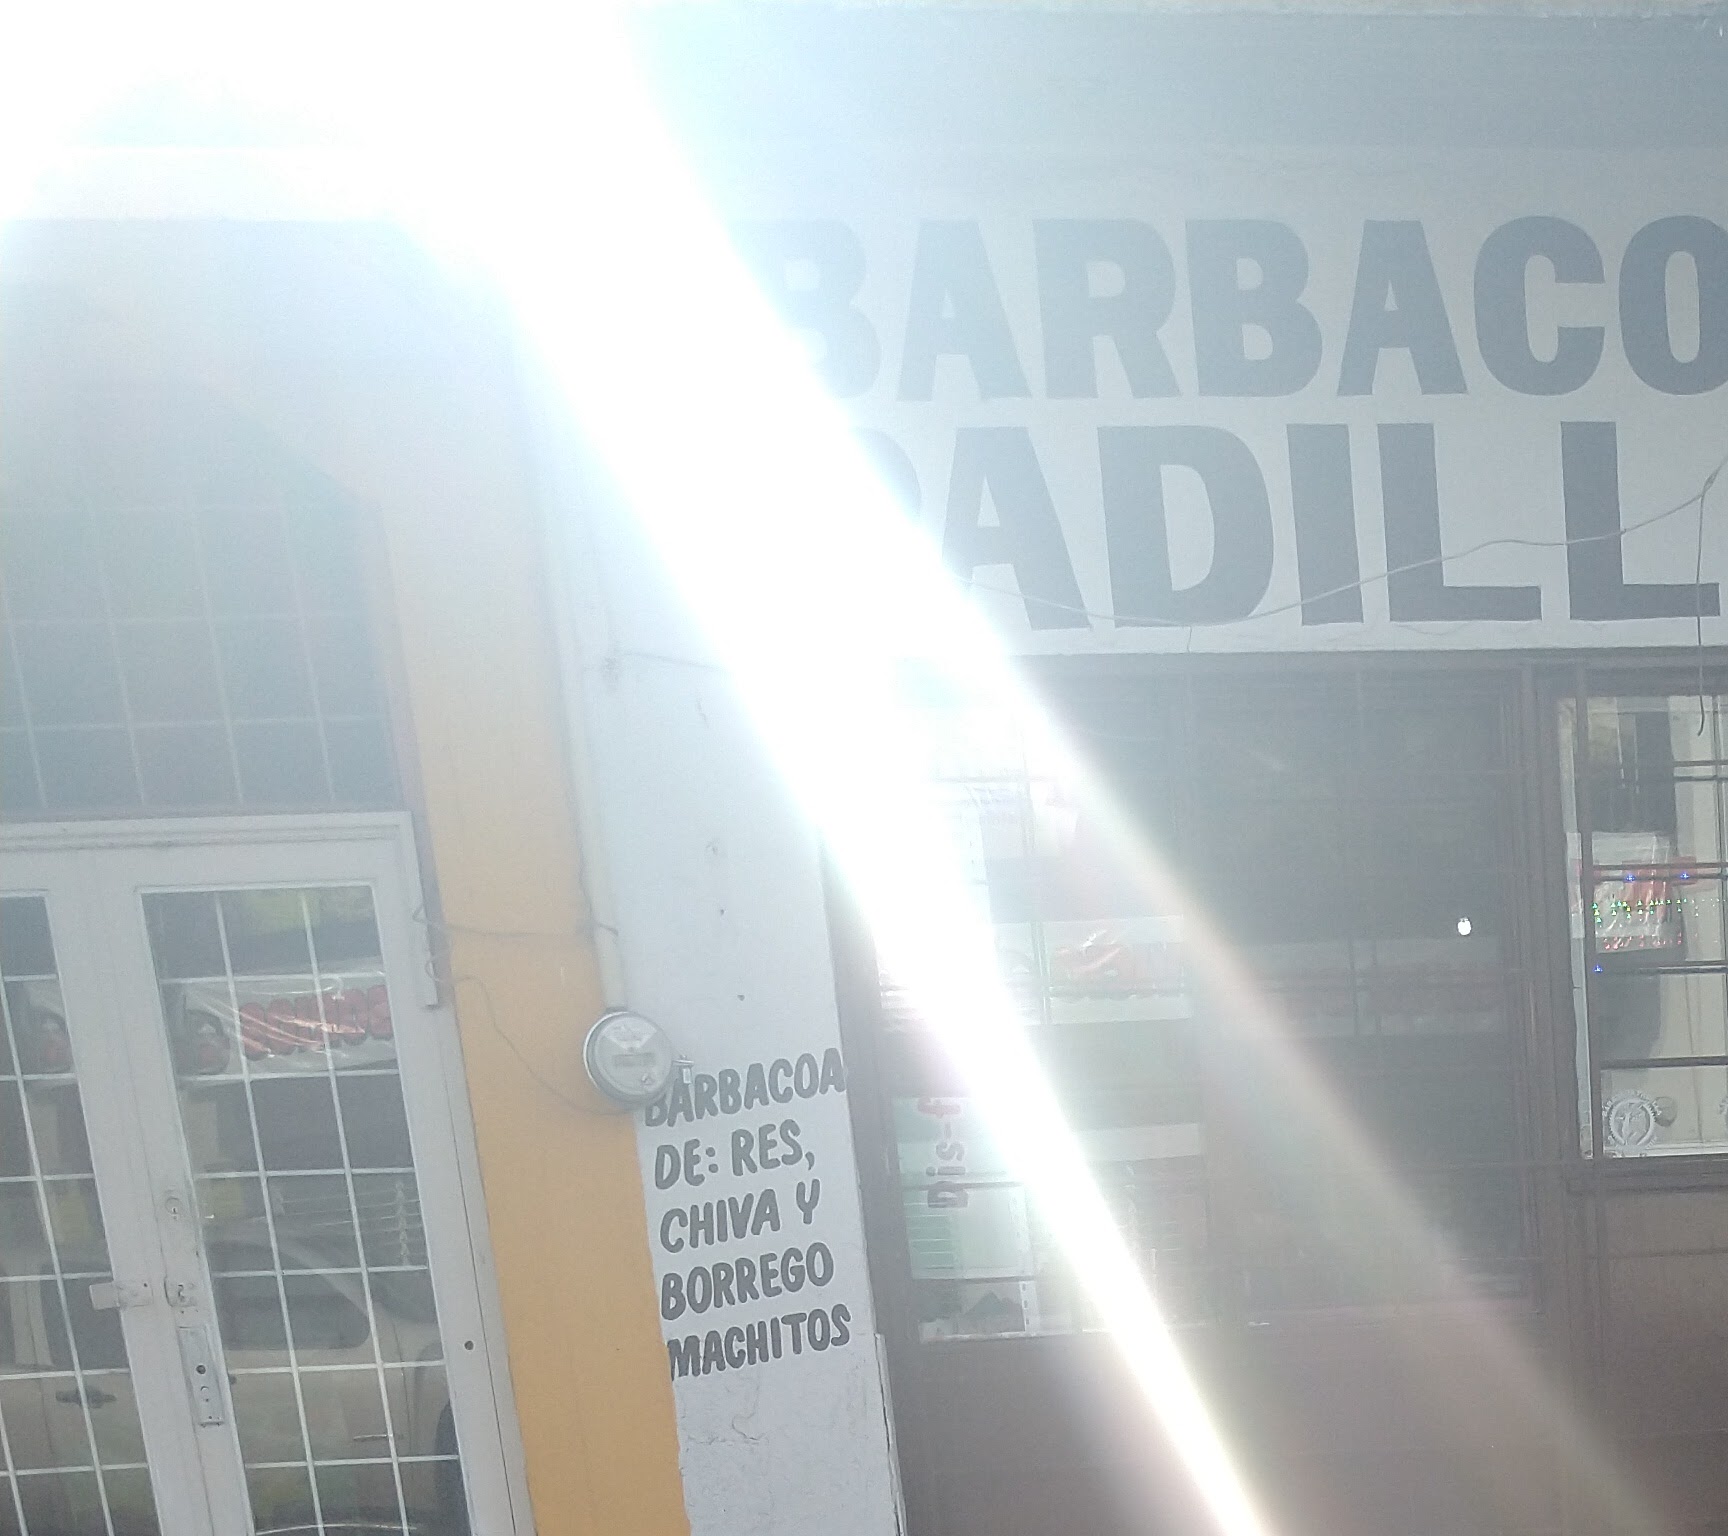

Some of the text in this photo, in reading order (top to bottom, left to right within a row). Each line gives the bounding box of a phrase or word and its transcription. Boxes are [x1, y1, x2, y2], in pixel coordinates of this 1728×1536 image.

[655, 1118, 816, 1190] DE: RES,
[660, 1178, 821, 1253] CHIVA Y
[660, 1241, 834, 1321] BORREGO
[666, 1302, 852, 1381] MACHITOS
